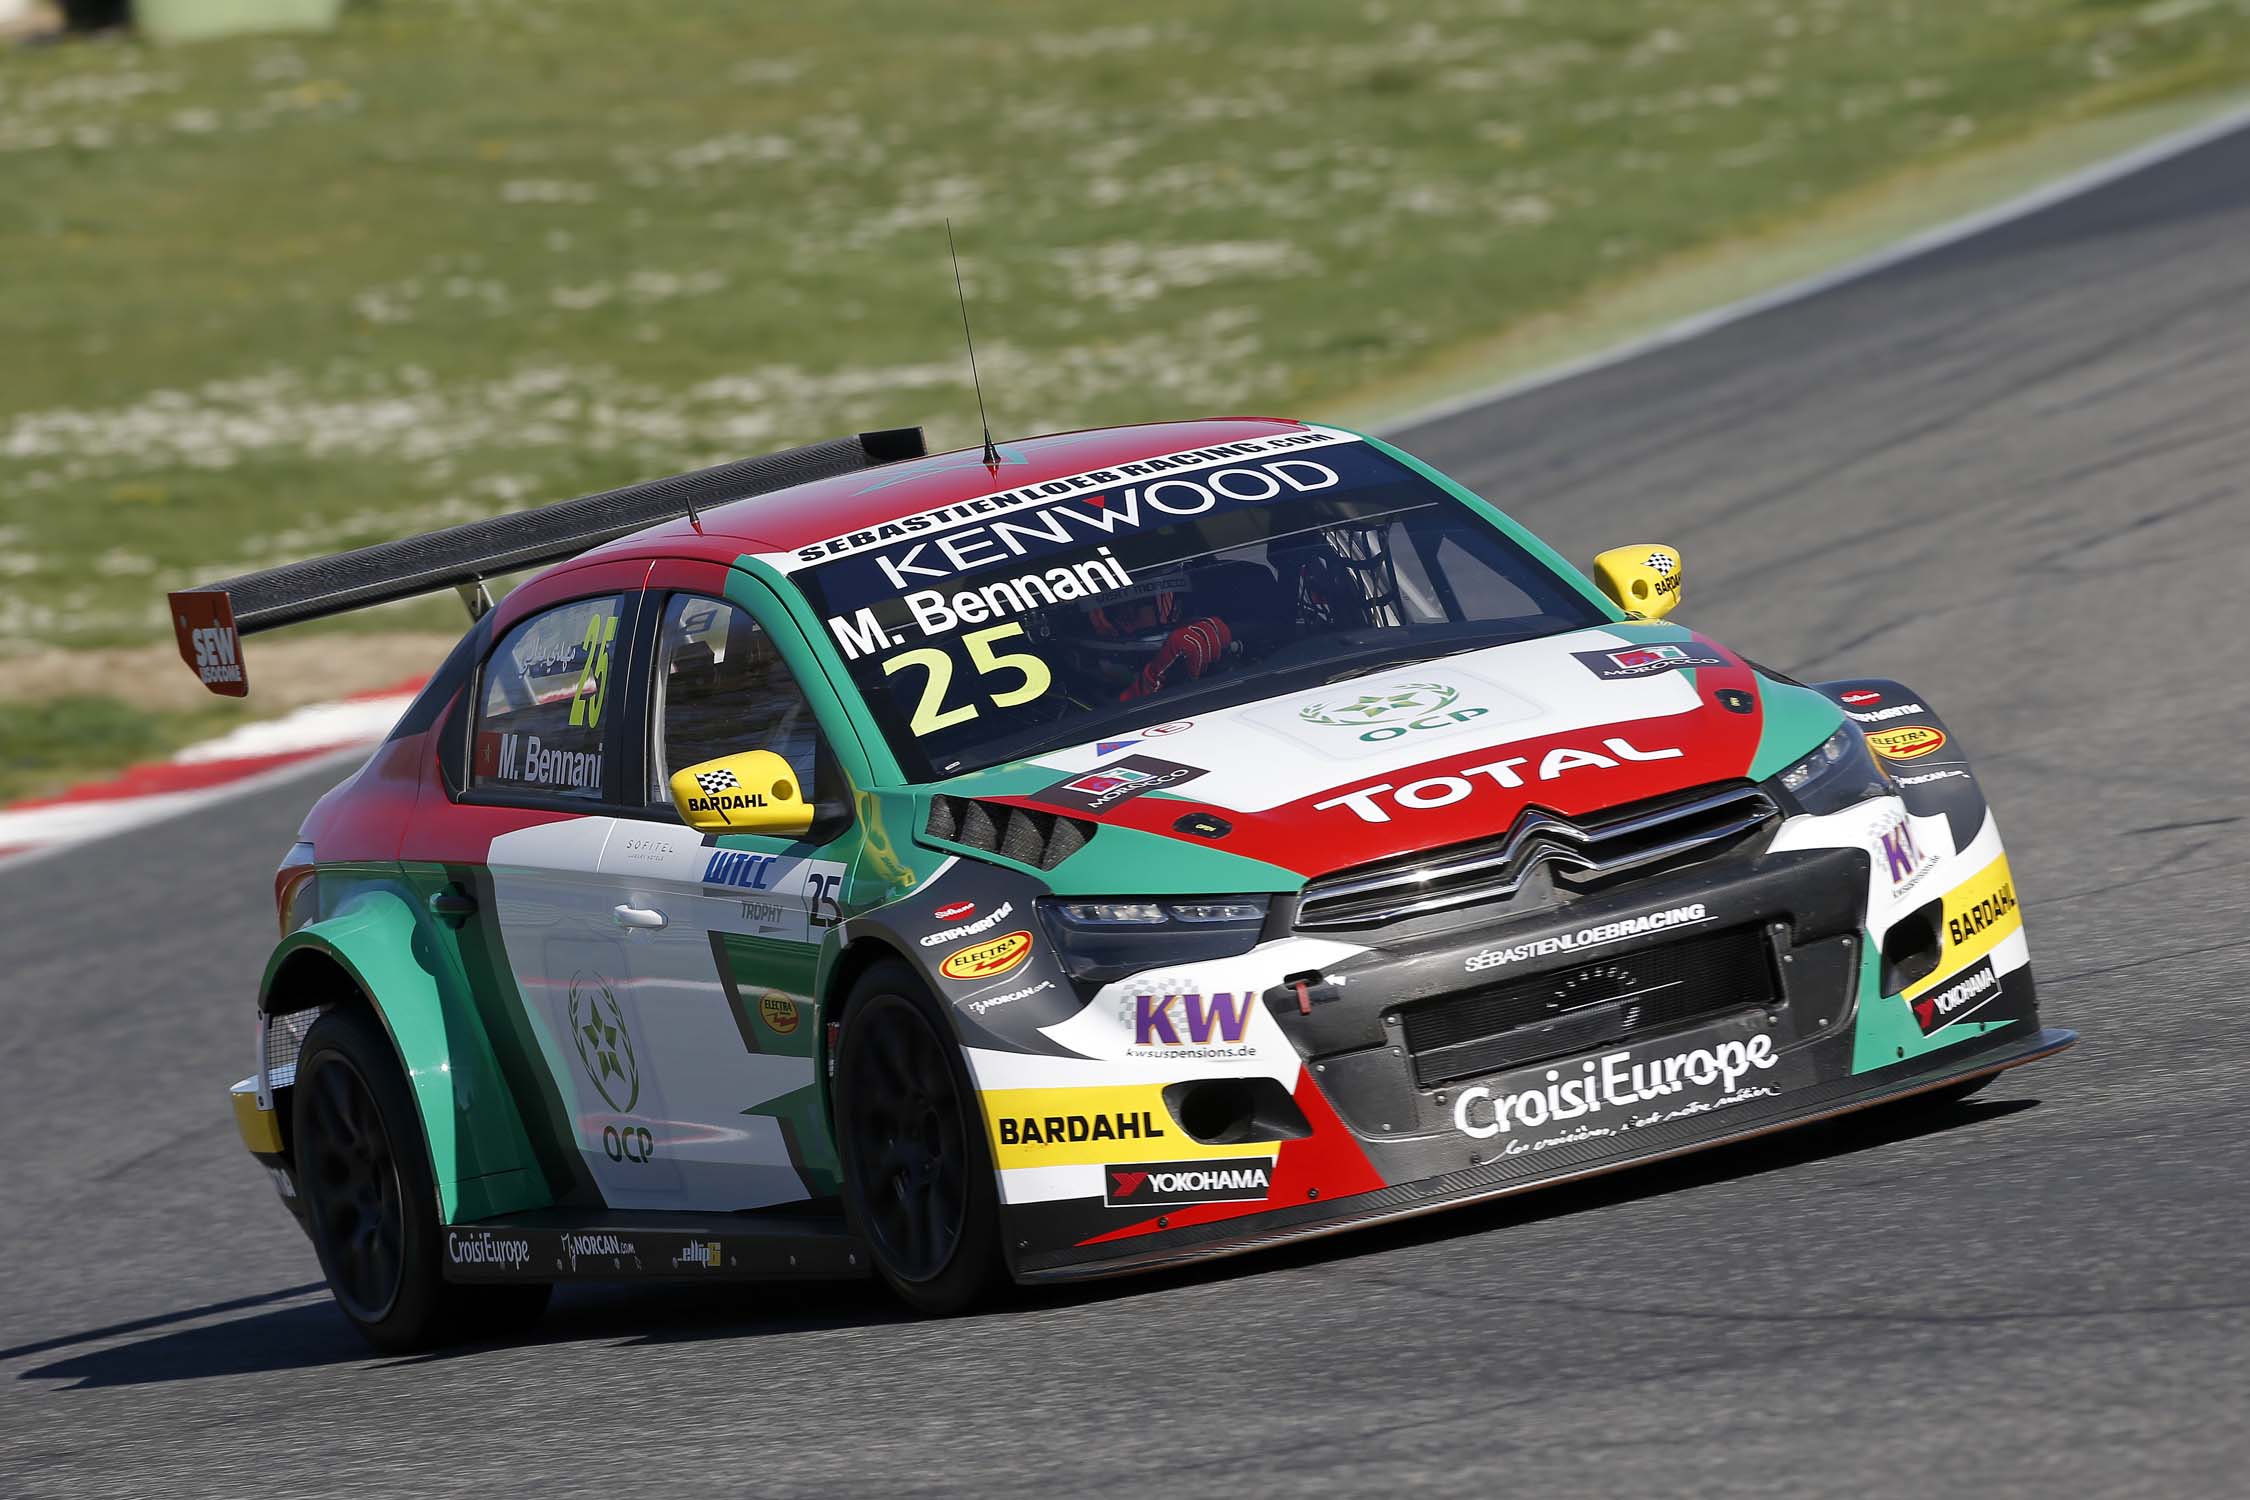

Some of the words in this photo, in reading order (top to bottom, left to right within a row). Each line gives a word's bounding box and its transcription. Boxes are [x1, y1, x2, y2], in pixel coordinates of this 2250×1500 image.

[875, 460, 1339, 590] KENWOOD
[827, 608, 903, 661] M.
[911, 546, 1136, 637] Bennani
[191, 627, 236, 667] SEW
[569, 614, 619, 728] 25
[882, 621, 1052, 738] 25
[1604, 658, 1720, 677] MOROCCO
[1359, 706, 1489, 742] OCP
[498, 733, 518, 780] M.
[524, 735, 603, 788] Bennani
[1088, 769, 1189, 808] MOROCCO
[1313, 737, 1684, 824] TOTAL
[688, 793, 768, 812] BARDAHL
[627, 839, 673, 853] SOFITEL
[703, 851, 777, 890] WTCC
[740, 900, 784, 923] TROPHY
[808, 873, 843, 927] 25
[954, 939, 1017, 966] ELECTRA
[764, 999, 792, 1012] ELECTRA
[1935, 966, 1997, 1015] YOKOHAMA
[1135, 991, 1256, 1045] KW
[1126, 1046, 1257, 1059] kwsuspensions.de
[1455, 1033, 1779, 1139] CroisiEurope
[603, 1125, 653, 1163] OCP
[999, 1112, 1164, 1145] BARDAHL
[1148, 1168, 1269, 1192] YOKOHAMA
[450, 1231, 530, 1270] CroisiEurope
